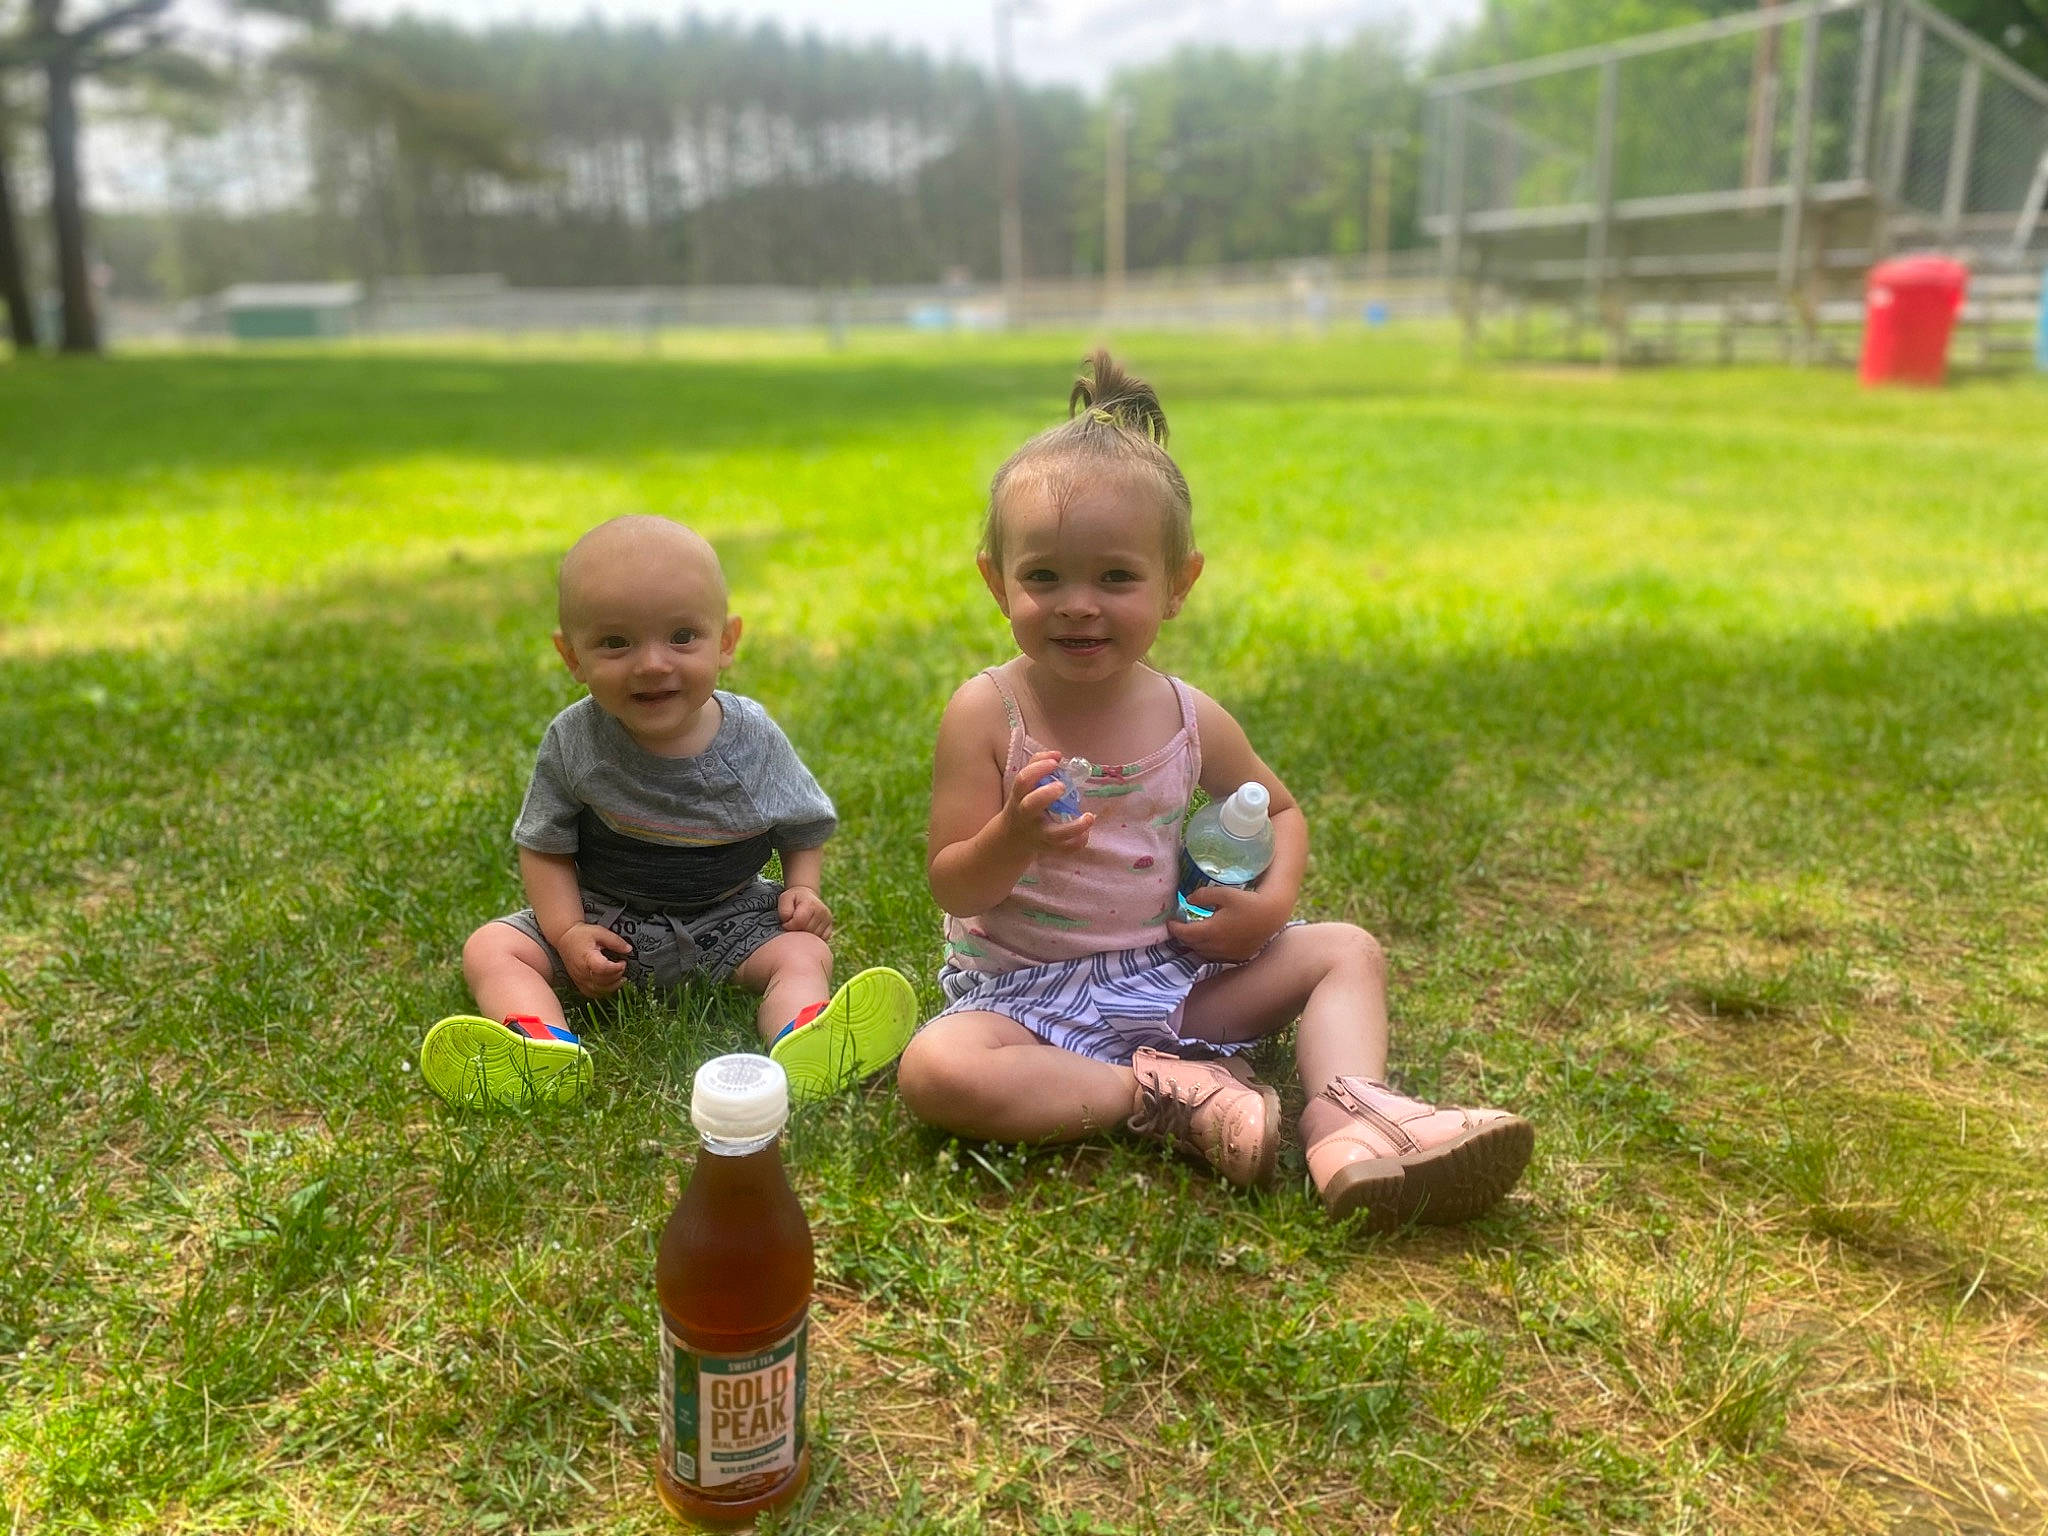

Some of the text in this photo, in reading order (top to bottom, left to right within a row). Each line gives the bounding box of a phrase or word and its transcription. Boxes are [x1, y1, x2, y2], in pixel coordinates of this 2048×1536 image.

[728, 1354, 774, 1372] SWEET TEA
[711, 1365, 787, 1409] GOLD
[711, 1393, 787, 1440] PEAK
